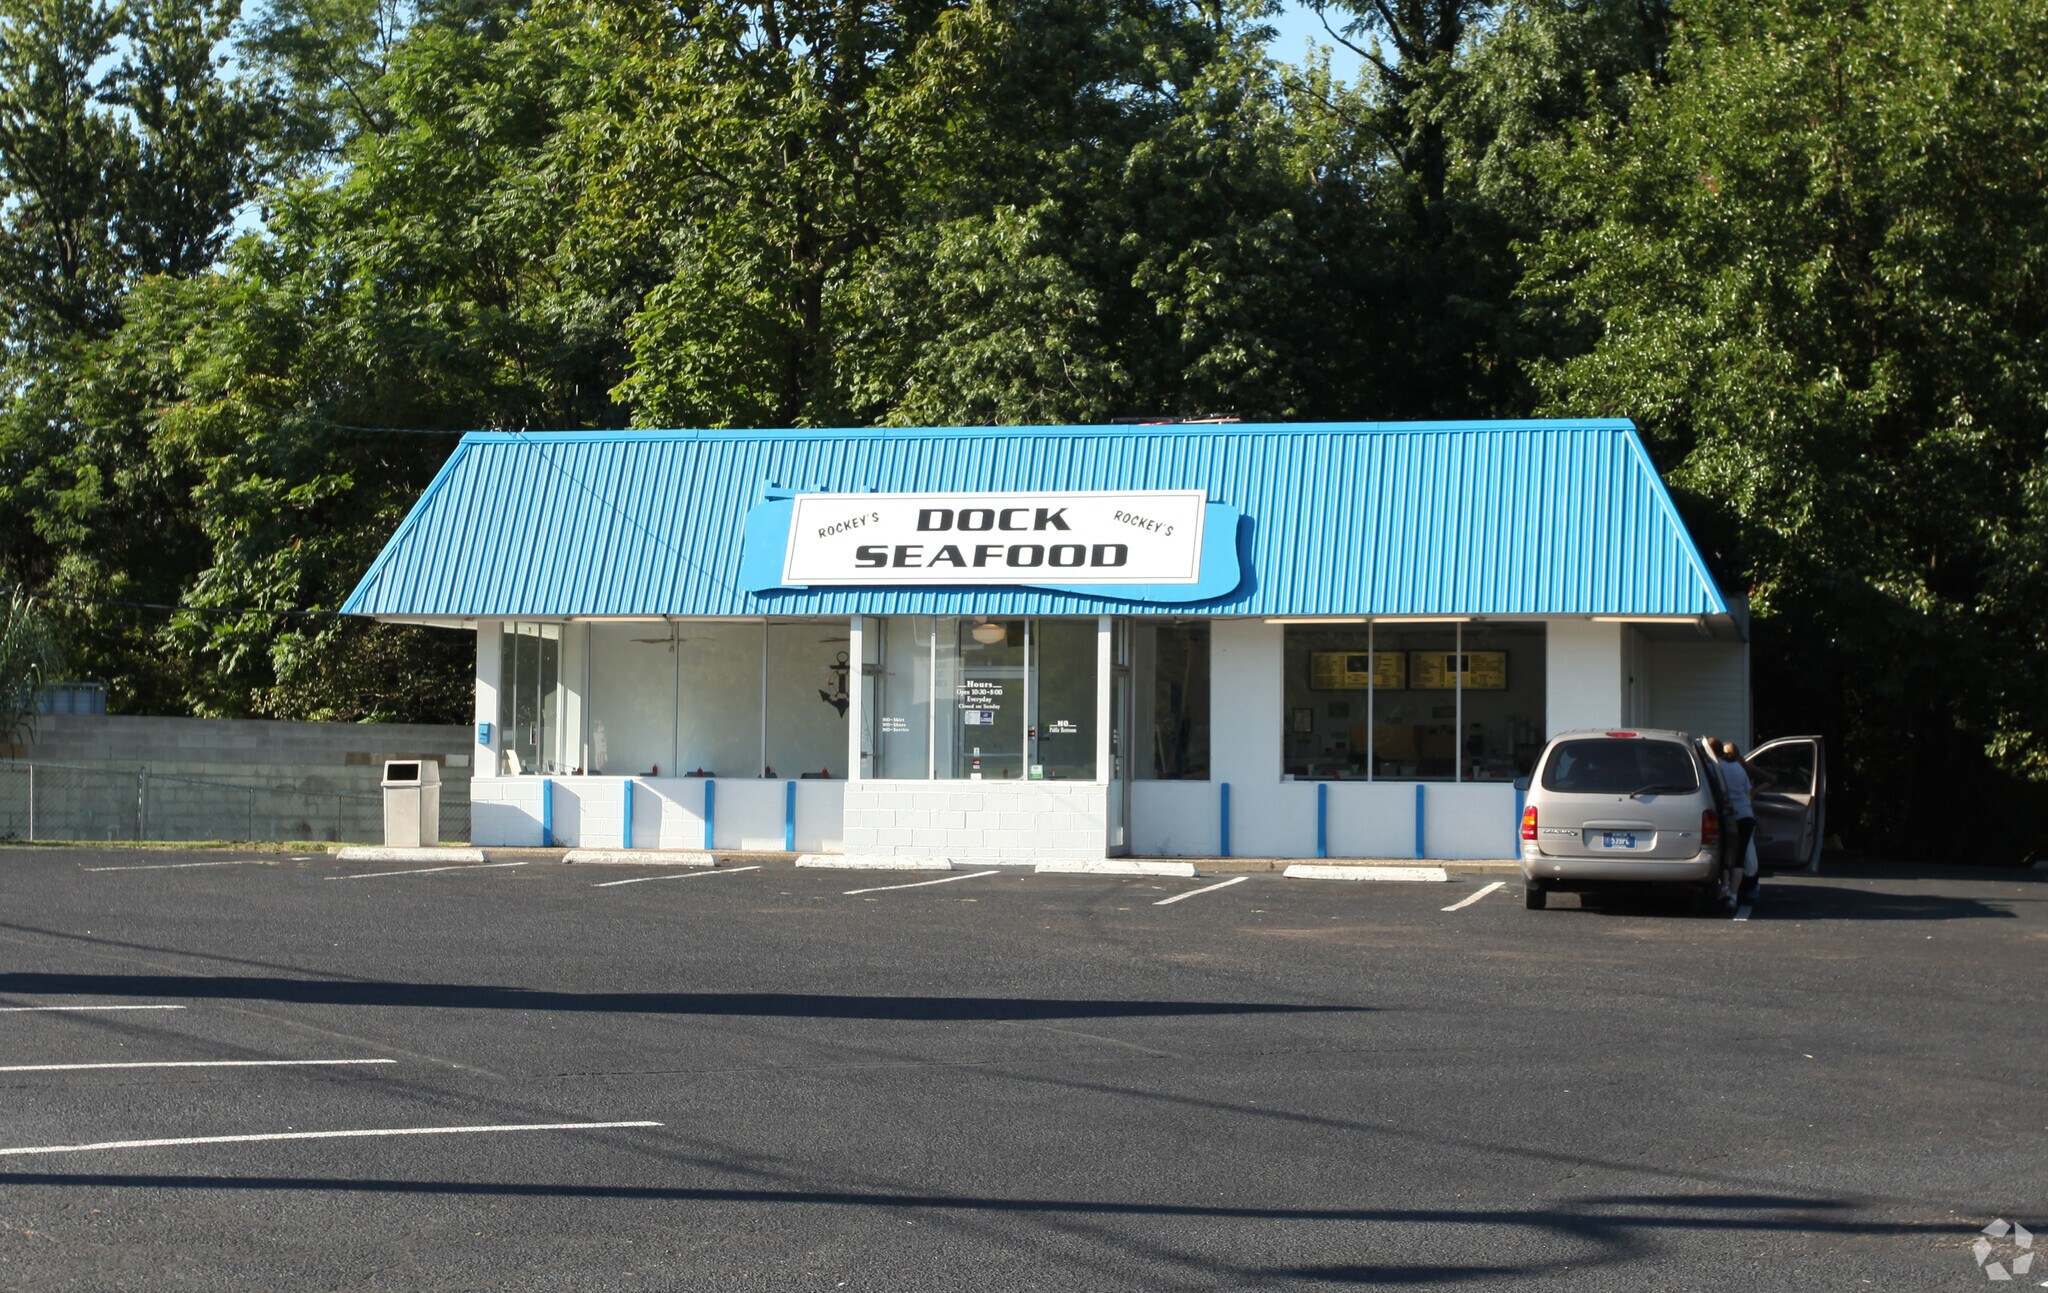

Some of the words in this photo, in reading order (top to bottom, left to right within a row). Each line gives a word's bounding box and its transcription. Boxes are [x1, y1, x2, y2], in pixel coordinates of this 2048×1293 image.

[818, 512, 879, 539] ROCKEY'S
[916, 507, 1071, 532] DOCK
[1113, 510, 1174, 537] ROCKEY'S
[854, 543, 1129, 569] SEAFOOD
[966, 680, 993, 688] Hours
[966, 696, 992, 704] Everyday
